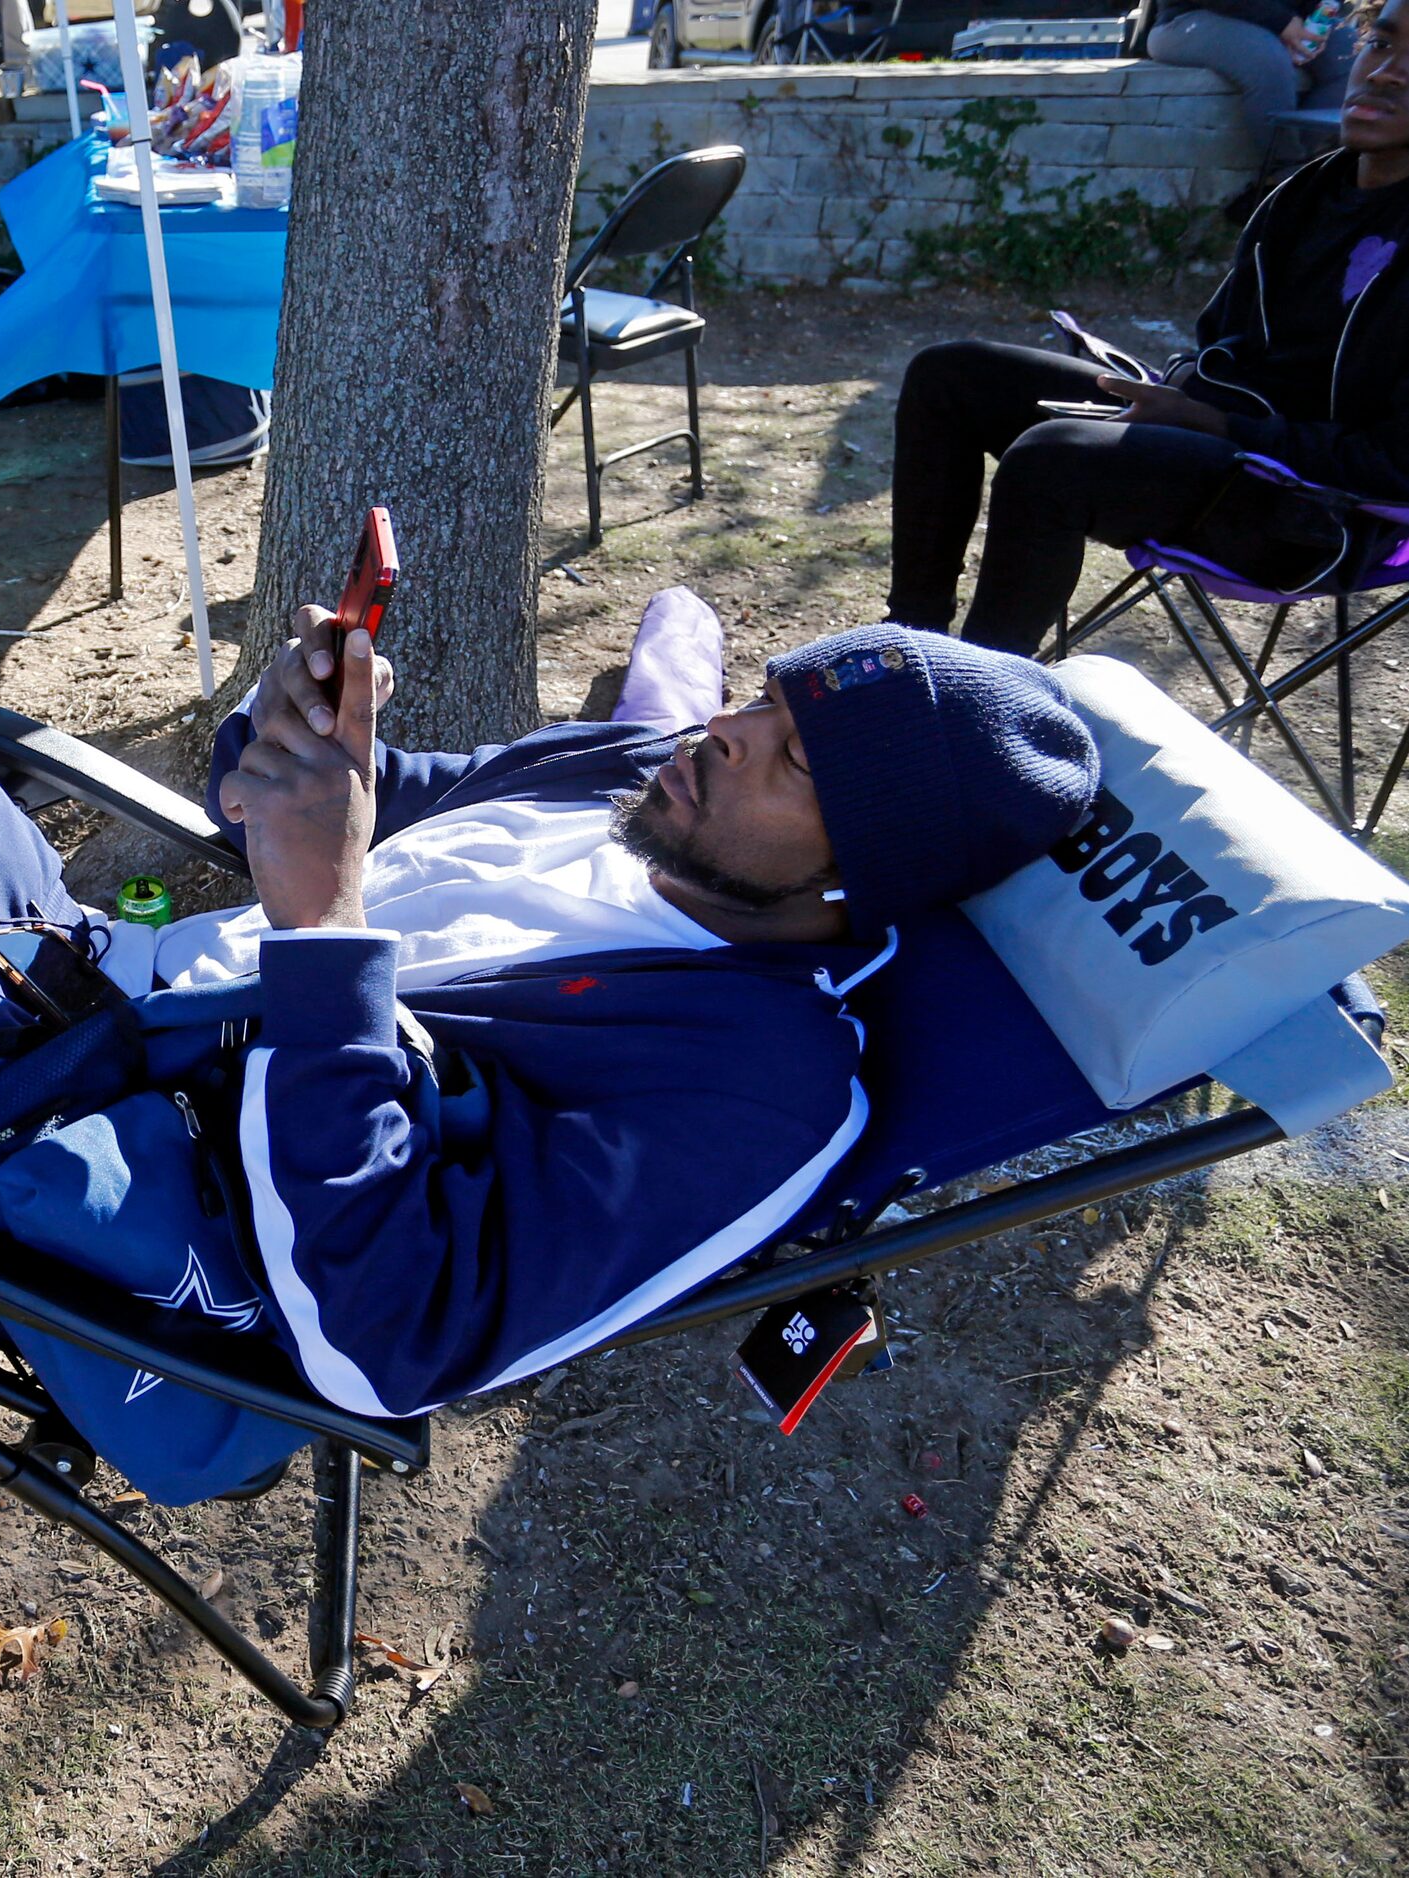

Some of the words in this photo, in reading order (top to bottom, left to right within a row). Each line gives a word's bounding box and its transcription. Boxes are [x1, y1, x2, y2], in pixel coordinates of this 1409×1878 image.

[1048, 785, 1239, 967] BOYS
[738, 1365, 757, 1387] LIFETIME
[752, 1381, 774, 1409] WARRANTY
